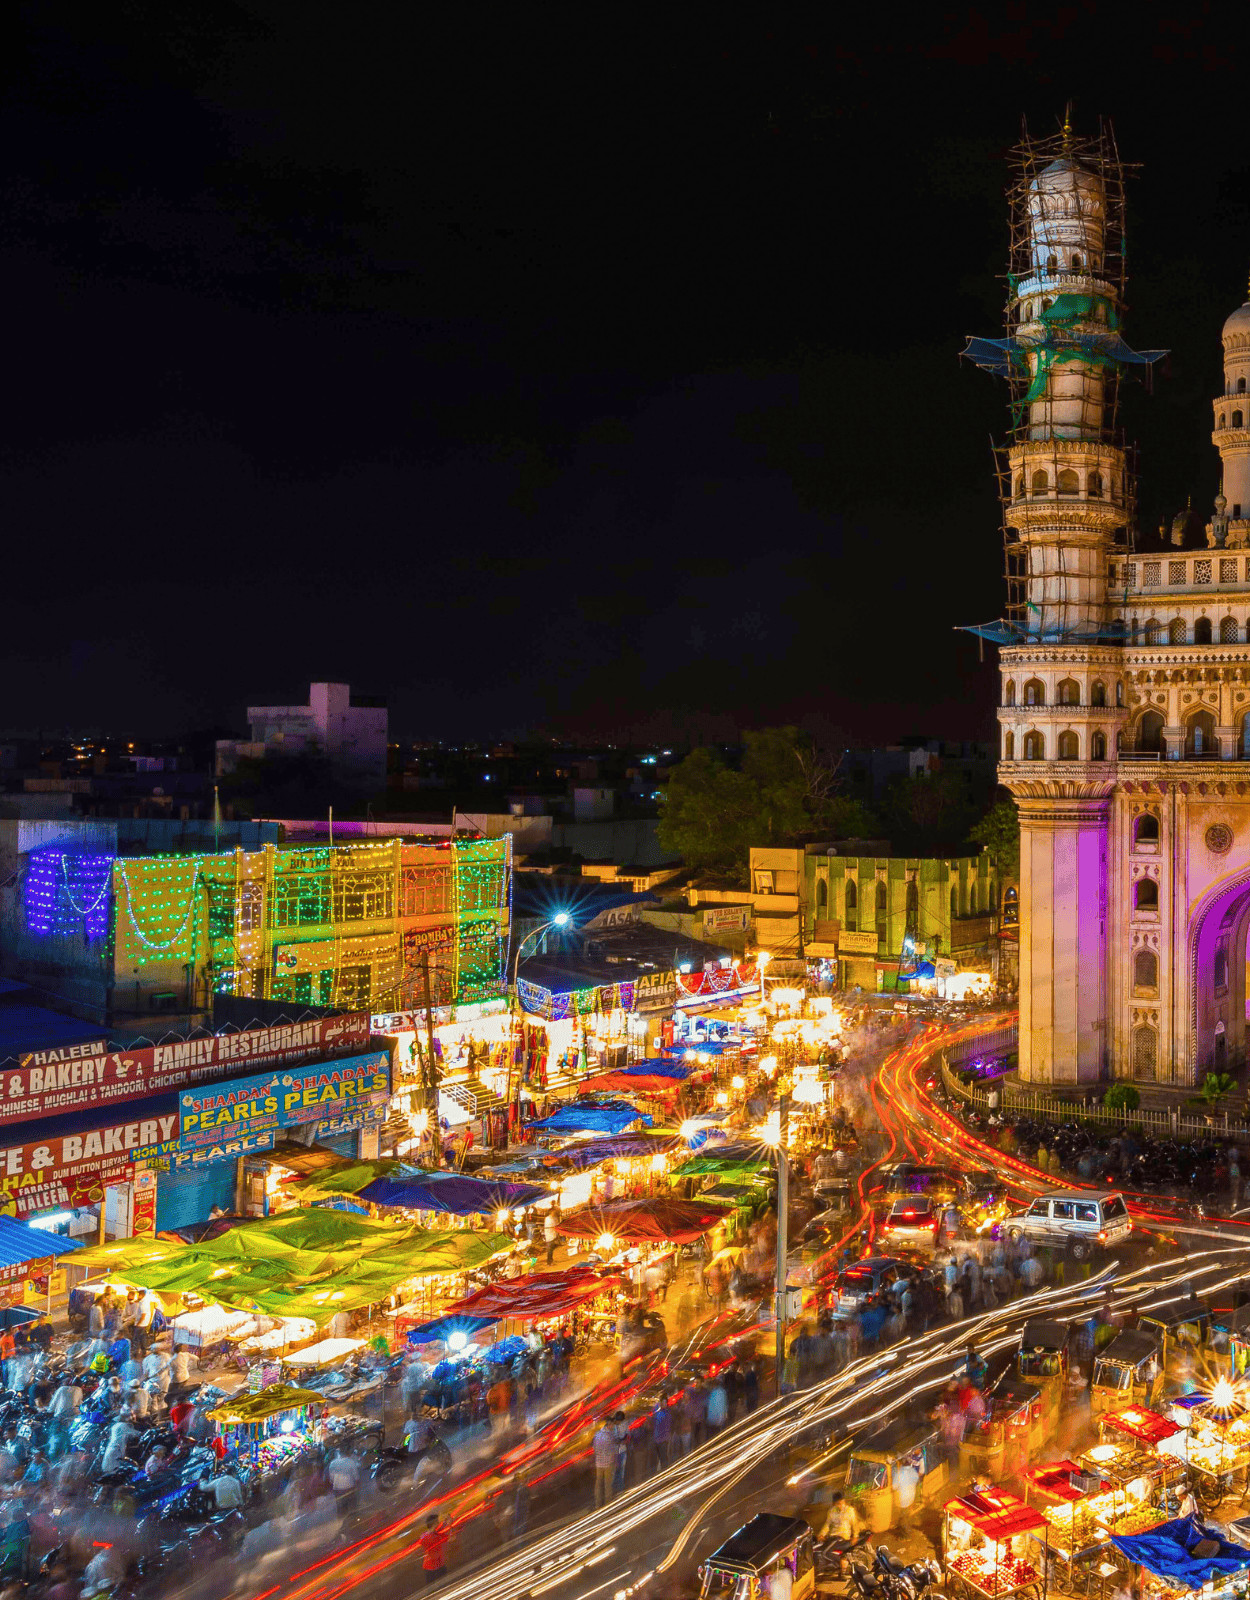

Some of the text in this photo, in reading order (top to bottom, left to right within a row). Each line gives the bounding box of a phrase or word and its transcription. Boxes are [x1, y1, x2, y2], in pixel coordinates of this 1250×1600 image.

[415, 928, 454, 946] BOMBAY
[638, 984, 676, 998] PEARLS
[34, 1042, 103, 1065] HALEEM
[154, 1021, 322, 1072] FAMILY RESTAURANT
[9, 1075, 24, 1098] &
[30, 1057, 107, 1094] BAKERY
[136, 1062, 143, 1076] A
[45, 1091, 87, 1109] MUGHLAI
[90, 1089, 97, 1100] &
[190, 1062, 224, 1081] MUTTON
[227, 1059, 244, 1074] DUM
[292, 1064, 380, 1091] SHAADAN
[192, 1085, 272, 1113] SHAADAN
[284, 1074, 388, 1110] PEARLS
[183, 1096, 278, 1132] PEARLS
[319, 1106, 384, 1132] PEARLS
[31, 1146, 55, 1169] &
[62, 1115, 176, 1164] BAKERY
[132, 1147, 158, 1160] NON
[176, 1134, 270, 1167] PEARLS
[0, 1170, 43, 1191] HAI
[53, 1168, 69, 1180] DUM
[71, 1161, 100, 1176] MUTTON
[100, 1166, 126, 1180] URANT
[17, 1186, 69, 1212] HALEEM
[18, 1180, 63, 1196] FARASHA
